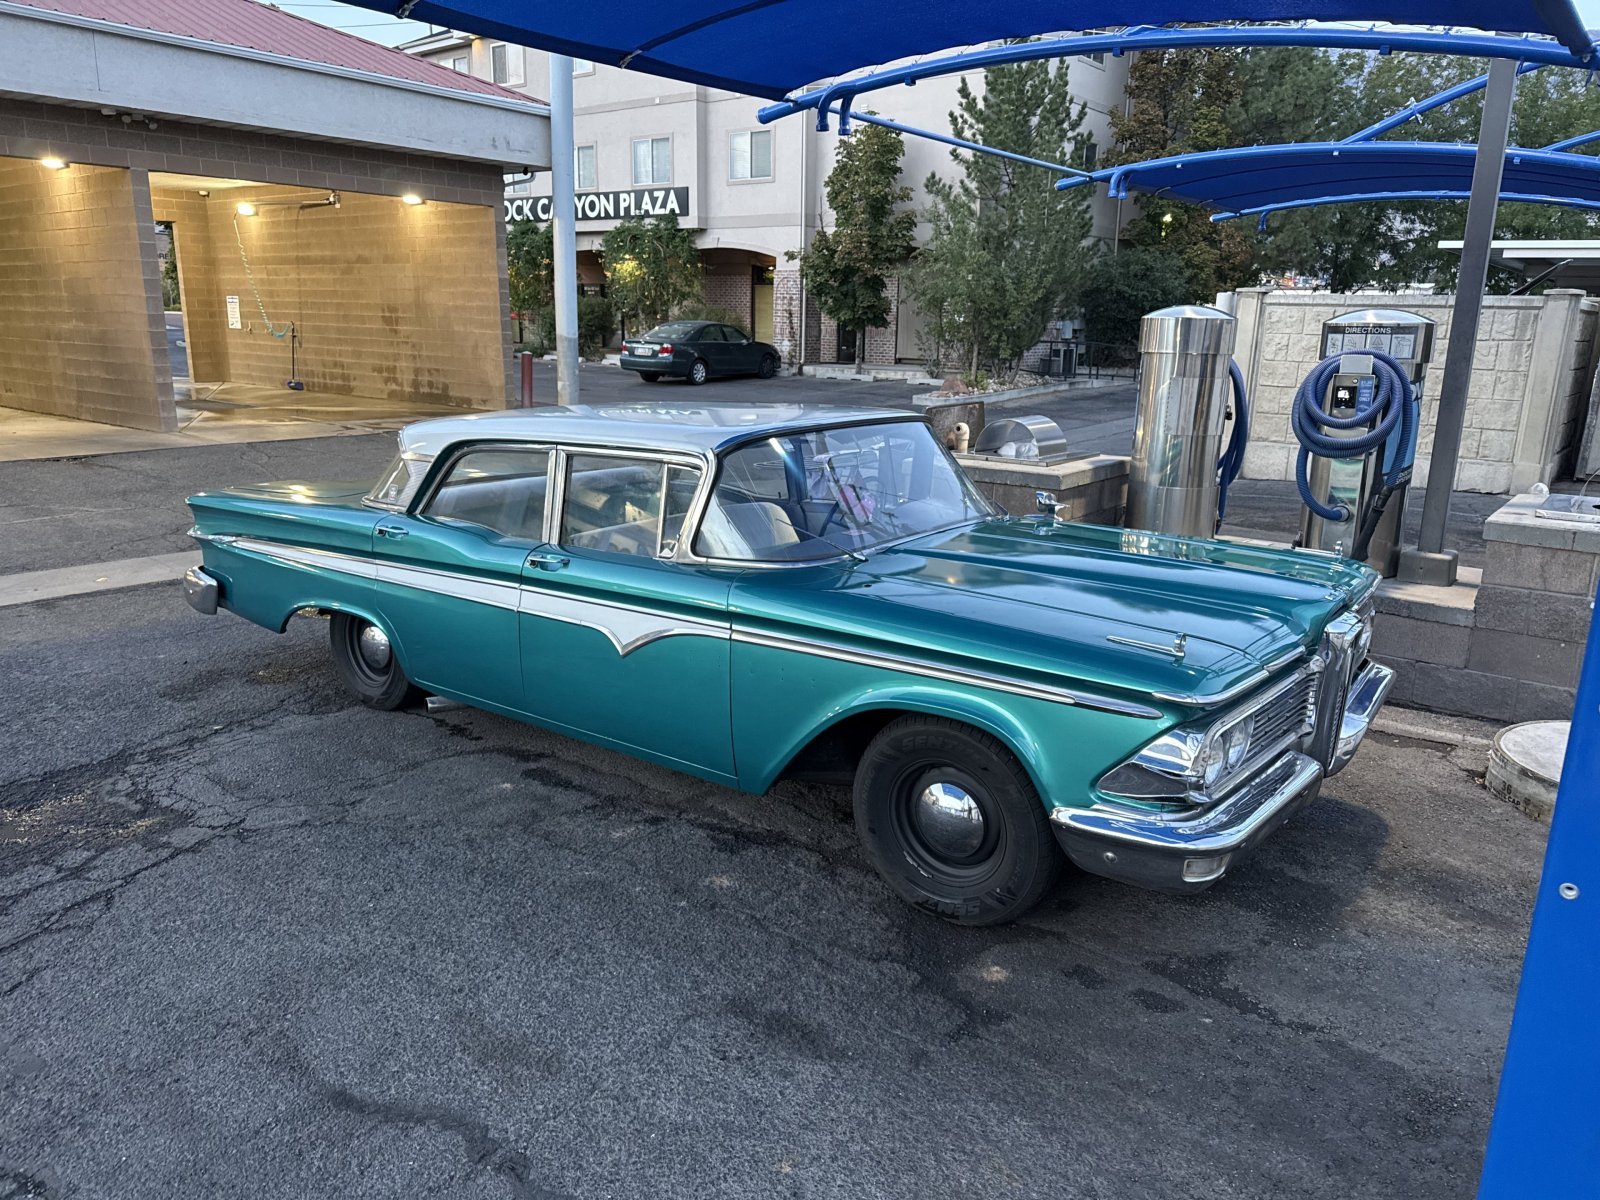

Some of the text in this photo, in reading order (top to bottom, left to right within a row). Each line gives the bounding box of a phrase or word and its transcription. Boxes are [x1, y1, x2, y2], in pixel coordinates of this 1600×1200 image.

[537, 194, 614, 221] CYON
[620, 189, 680, 217] PLAZA
[1345, 326, 1391, 334] DIRECTIONS
[1501, 780, 1512, 795] 36
